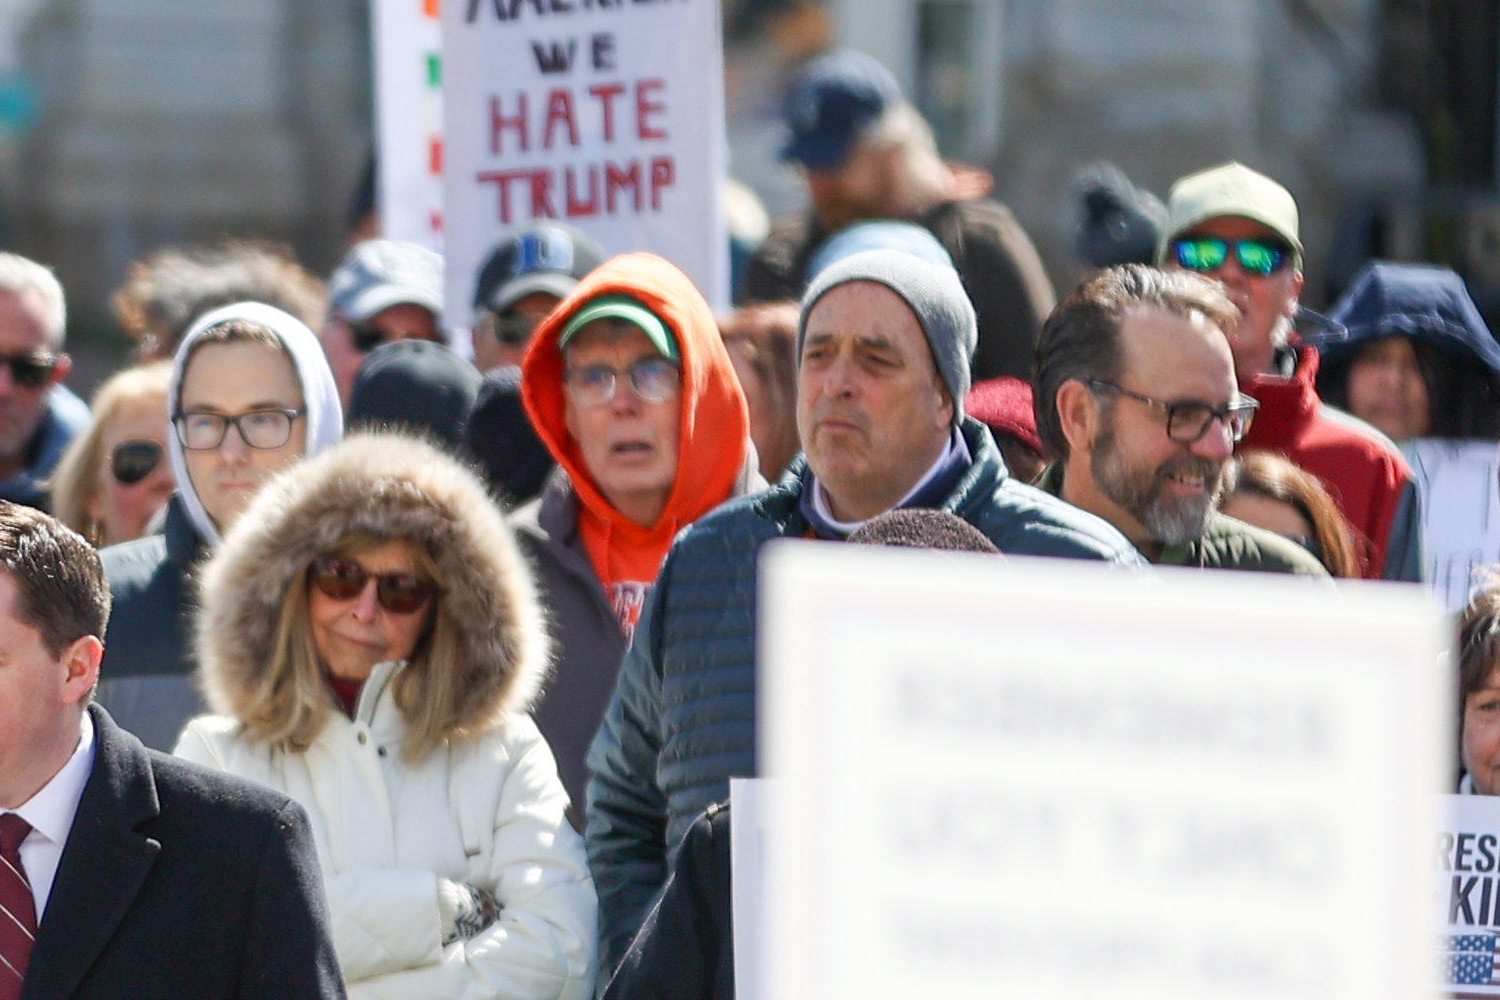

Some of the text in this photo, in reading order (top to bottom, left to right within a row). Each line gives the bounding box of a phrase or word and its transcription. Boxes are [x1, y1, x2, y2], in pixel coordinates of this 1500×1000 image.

[531, 33, 616, 74] WE
[489, 79, 668, 154] HATE
[476, 156, 675, 223] TRUMP
[1429, 832, 1500, 872] RES
